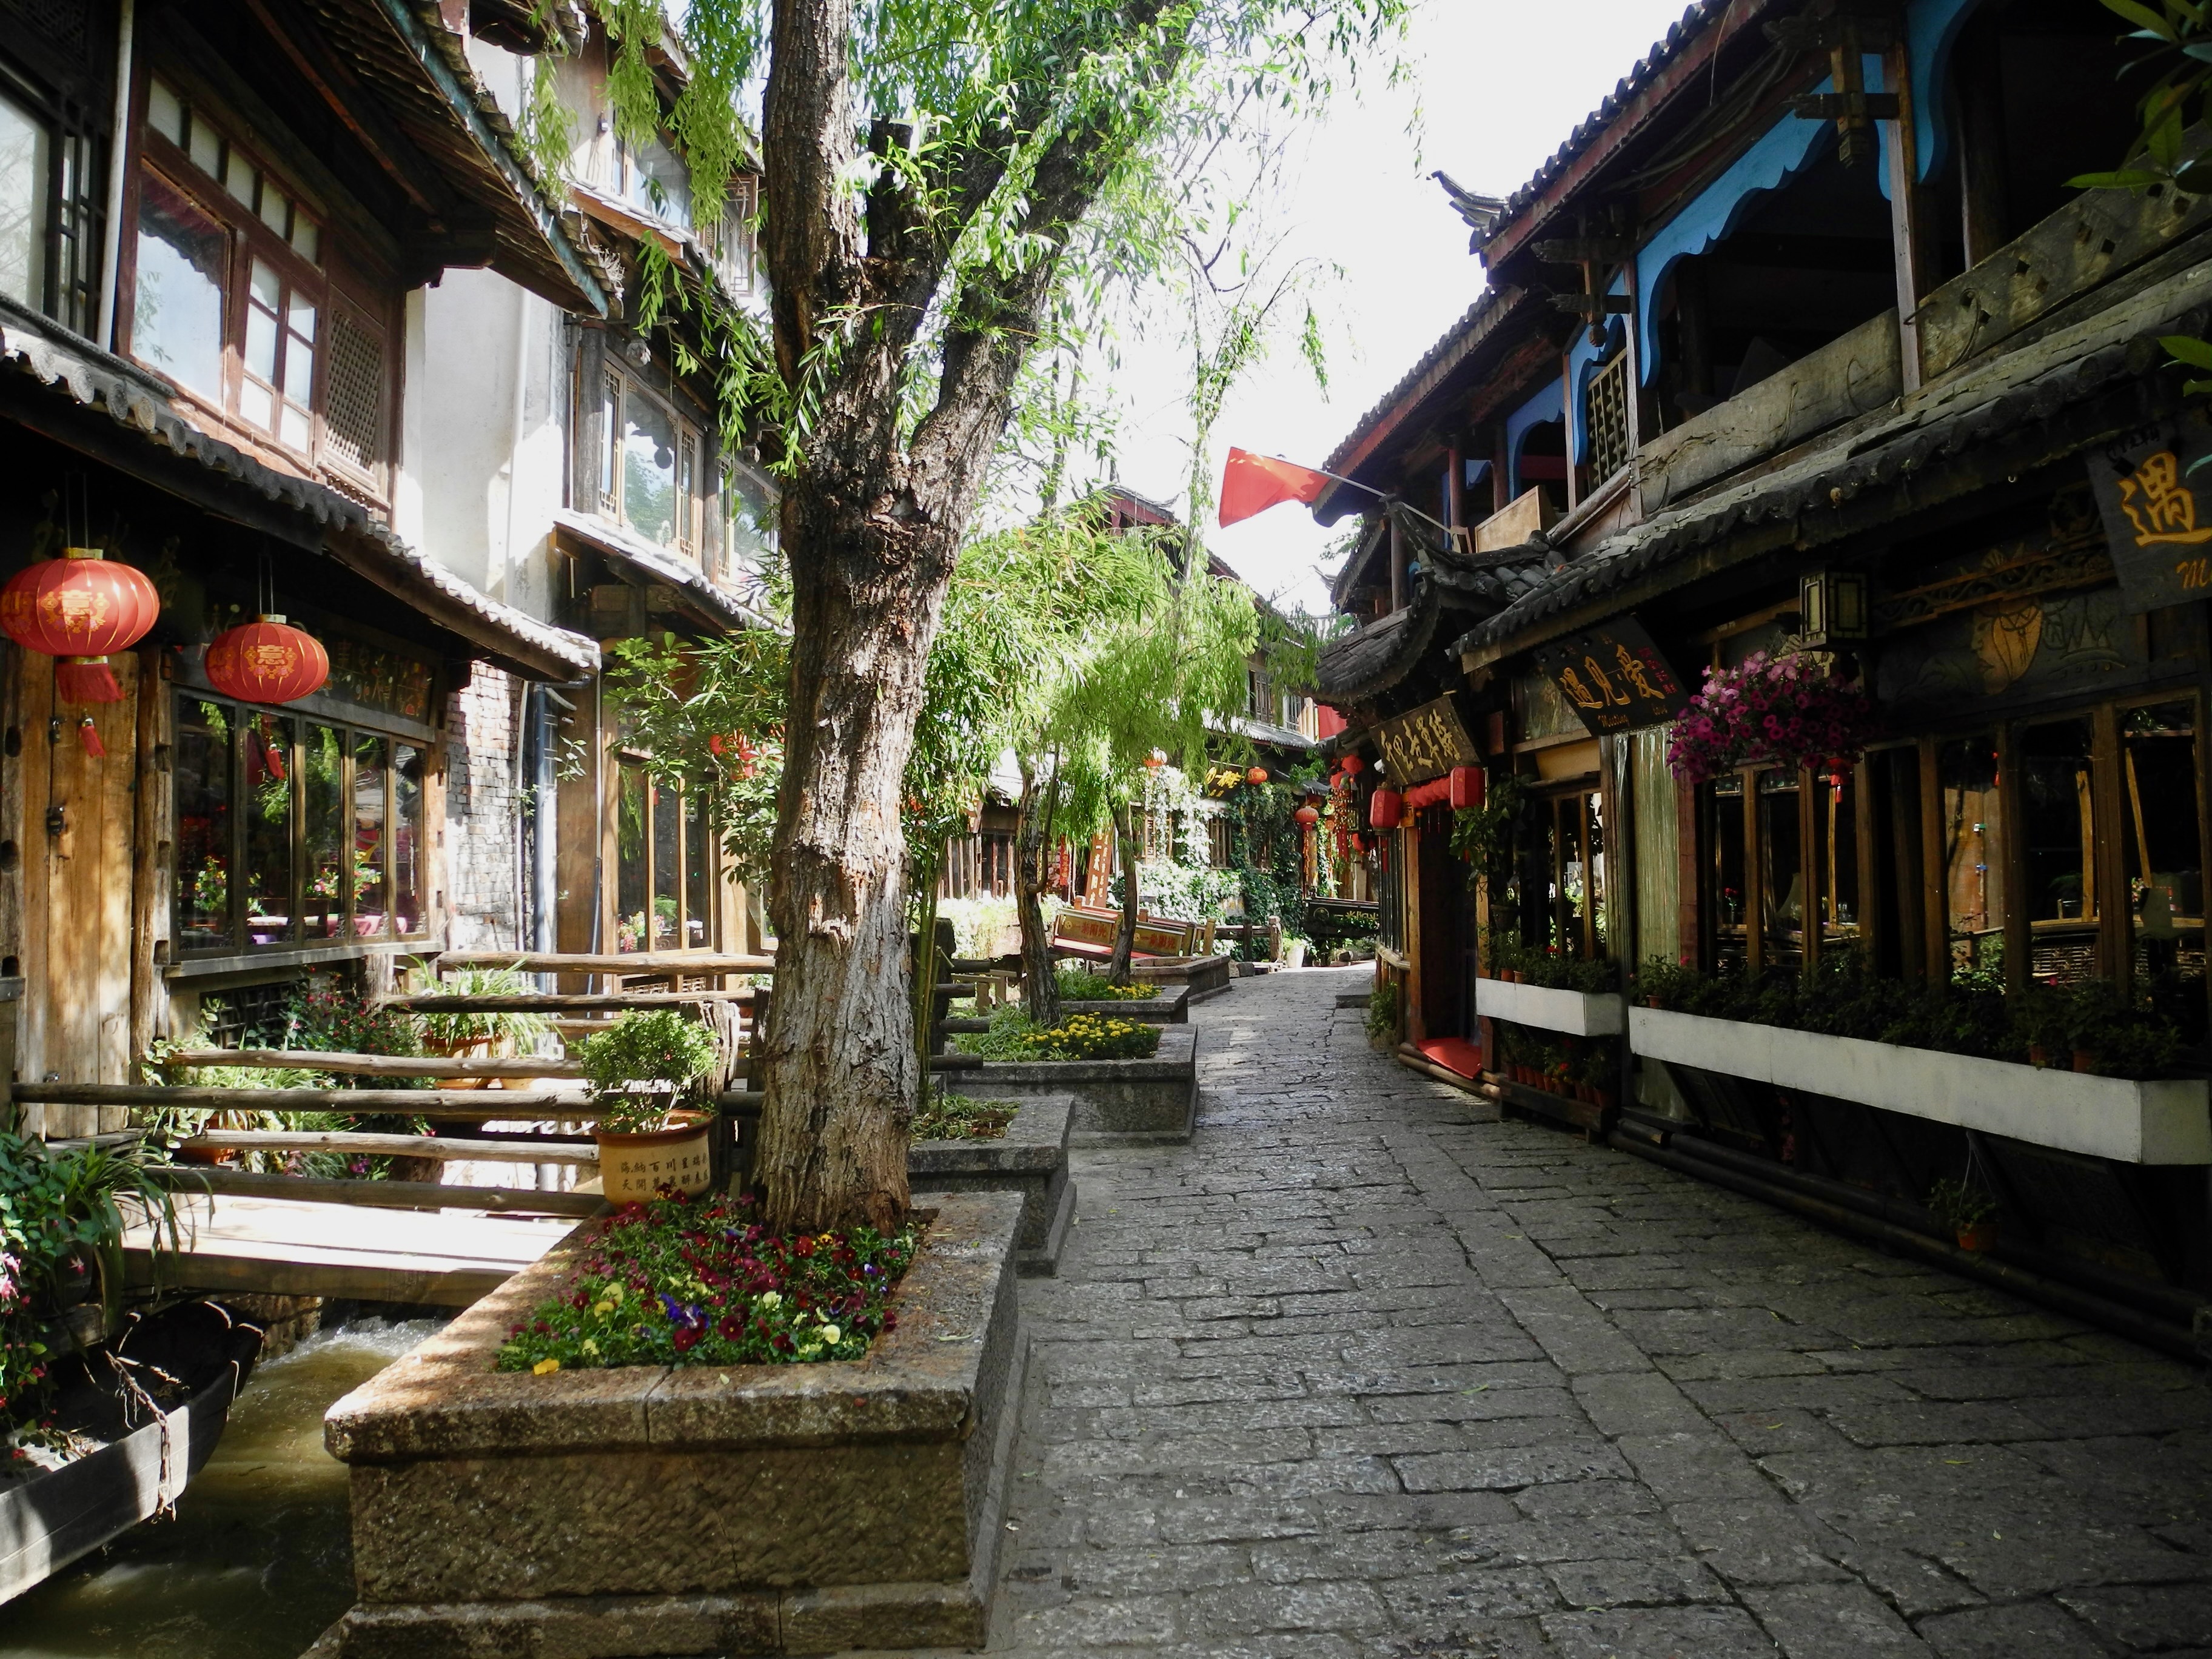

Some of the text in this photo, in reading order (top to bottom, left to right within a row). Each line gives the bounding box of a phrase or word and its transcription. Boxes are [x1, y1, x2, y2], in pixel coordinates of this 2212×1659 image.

[2175, 558, 2212, 590] M
[58, 589, 93, 615] 意
[256, 645, 285, 665] 意
